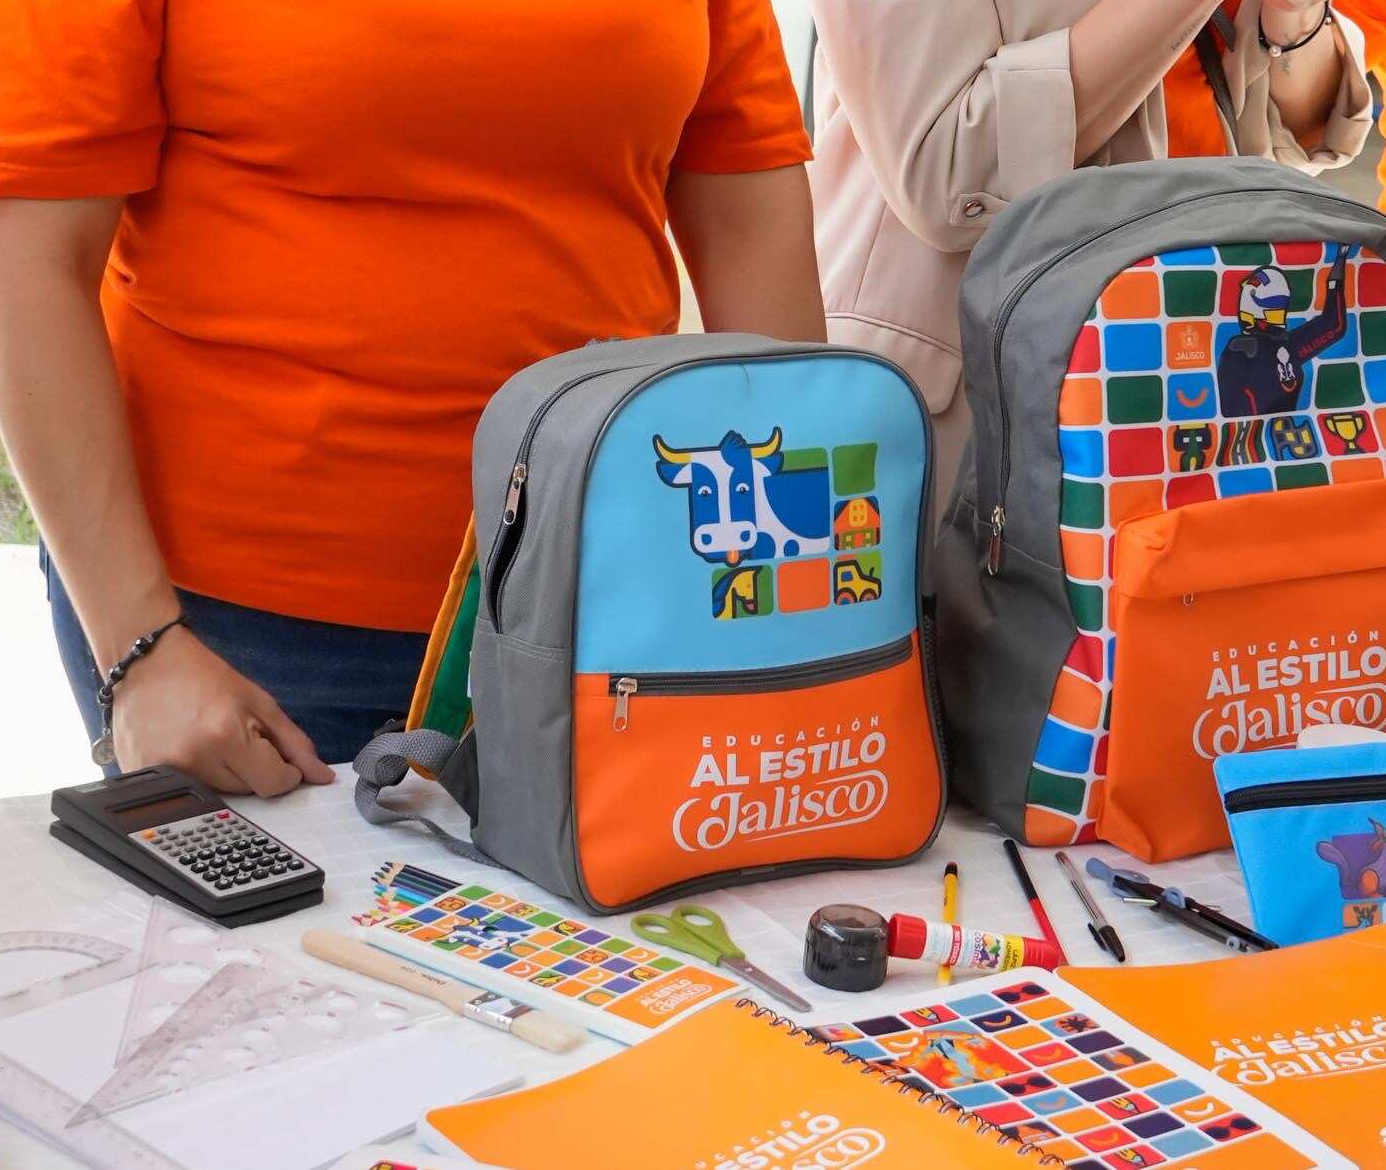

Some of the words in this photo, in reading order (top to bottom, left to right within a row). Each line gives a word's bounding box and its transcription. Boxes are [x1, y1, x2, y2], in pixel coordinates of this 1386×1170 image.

[1213, 630, 1379, 662] EDUCACIÓN
[1206, 664, 1250, 700] AL
[702, 716, 879, 748] EDUCACIÓN
[1211, 692, 1383, 756] Jalisco
[690, 753, 750, 788] AL
[760, 731, 886, 783] ESTILO
[693, 778, 878, 851] Jalisco
[1214, 1044, 1266, 1062] AL
